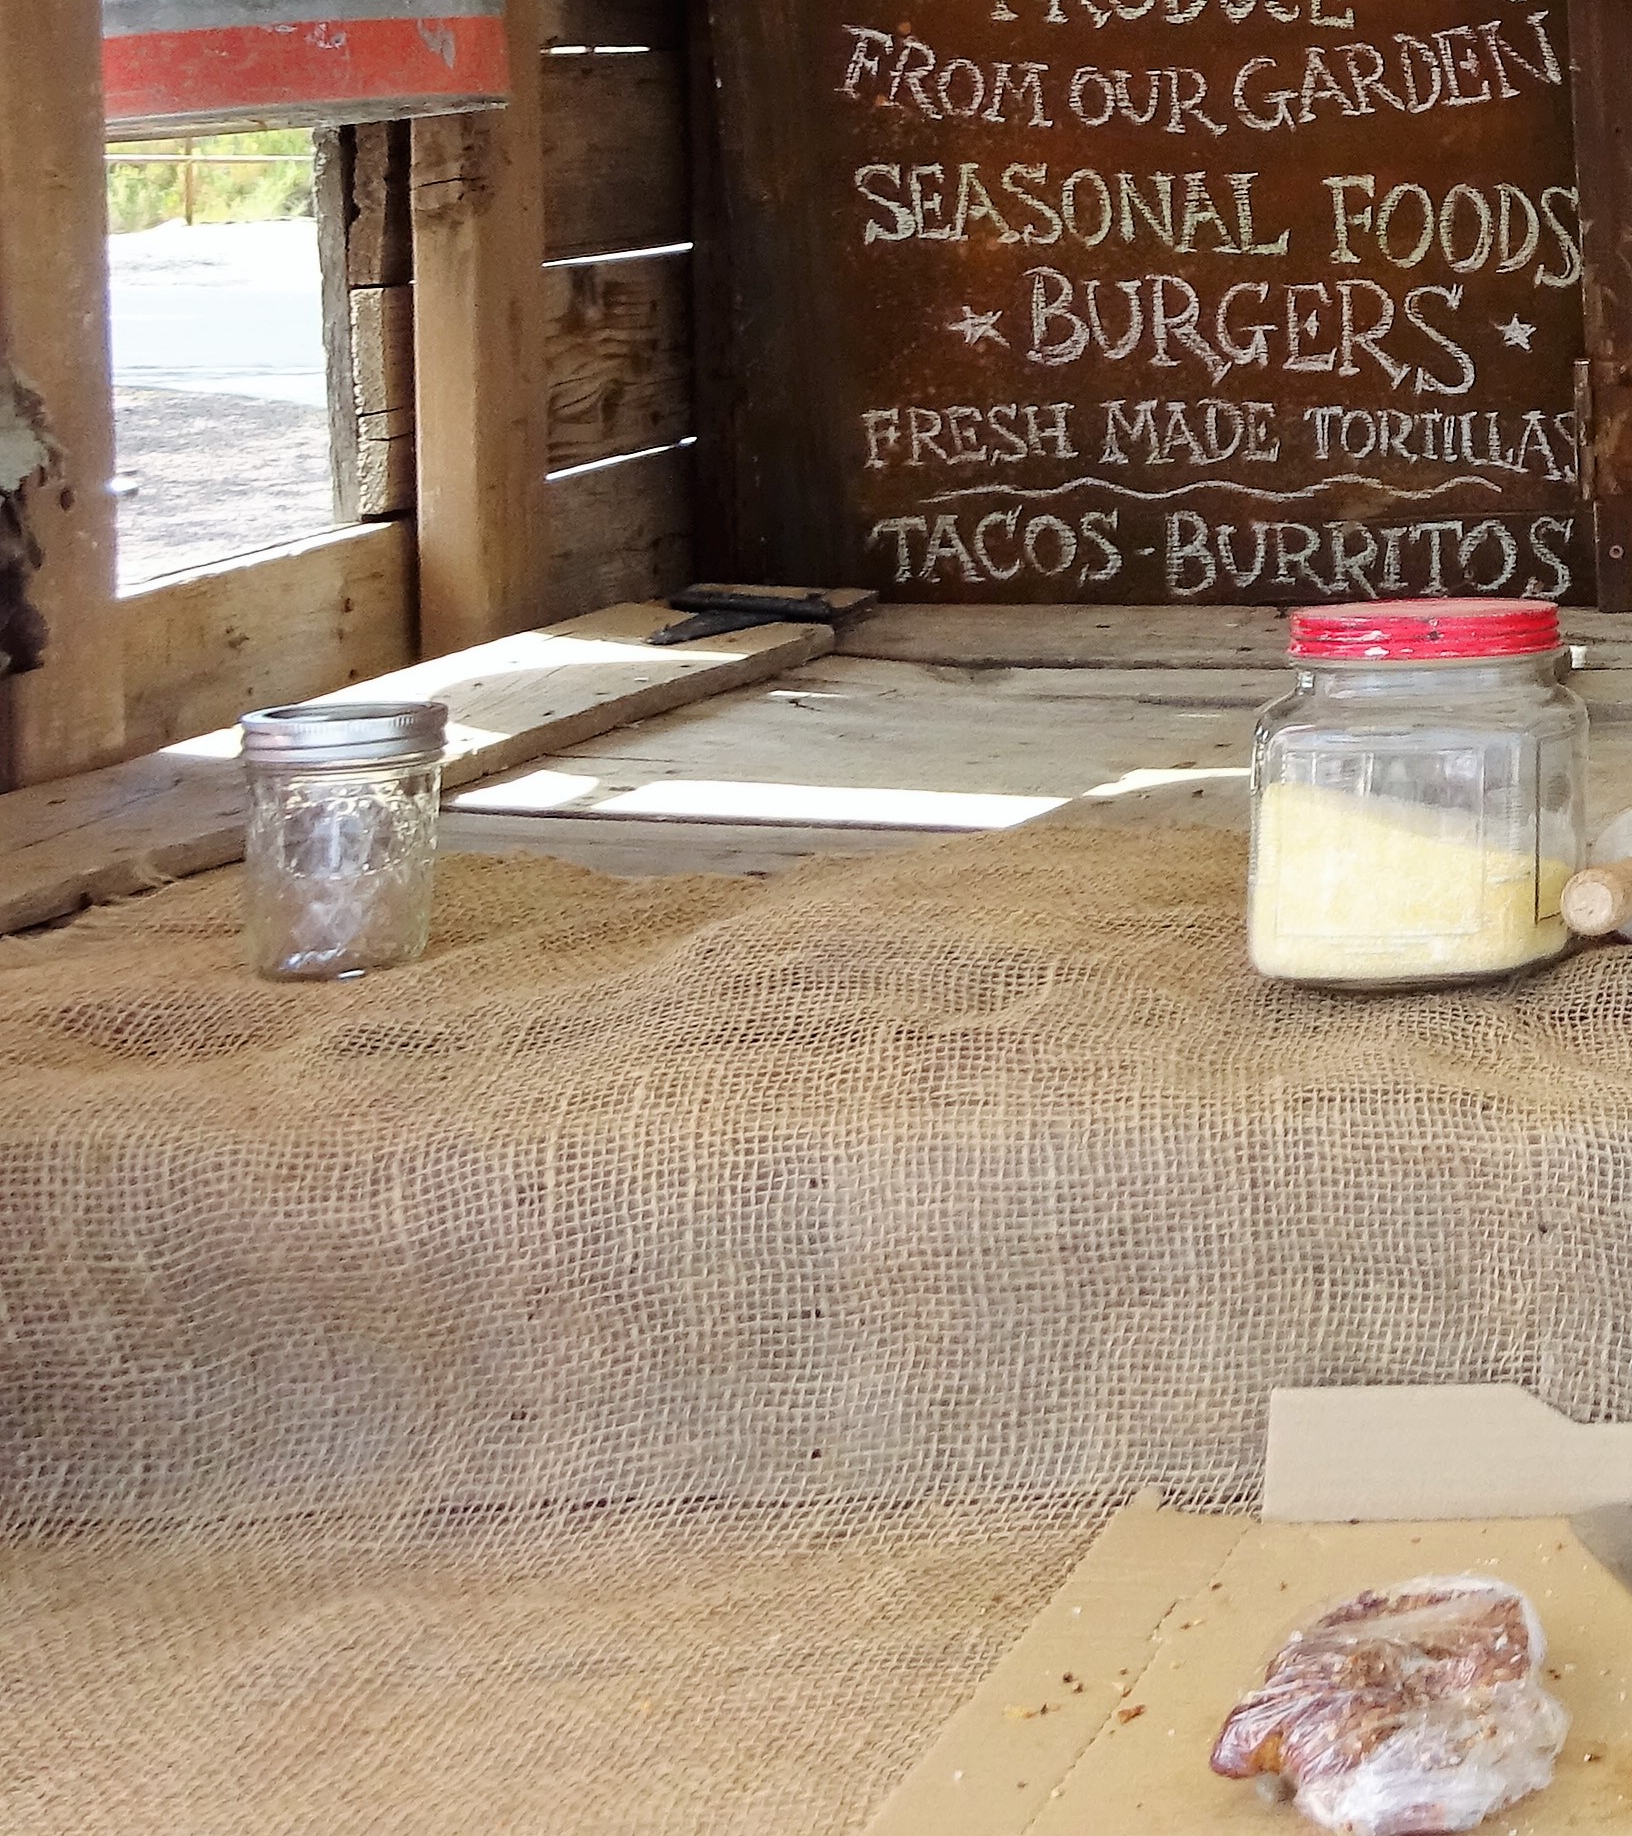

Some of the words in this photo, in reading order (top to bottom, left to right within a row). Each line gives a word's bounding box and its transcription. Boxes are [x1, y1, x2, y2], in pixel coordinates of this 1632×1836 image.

[835, 24, 1053, 128] FROM
[1069, 65, 1227, 135] OUR
[1234, 10, 1563, 132] GARDEN
[854, 163, 1289, 256] SEASONAL
[1323, 172, 1583, 289] FOODS
[1024, 266, 1474, 394] BURGERS
[862, 401, 1074, 469] FRESH
[1099, 399, 1282, 465] MADE
[869, 504, 1121, 587] TACOS
[1162, 509, 1576, 599] BURRITOS
